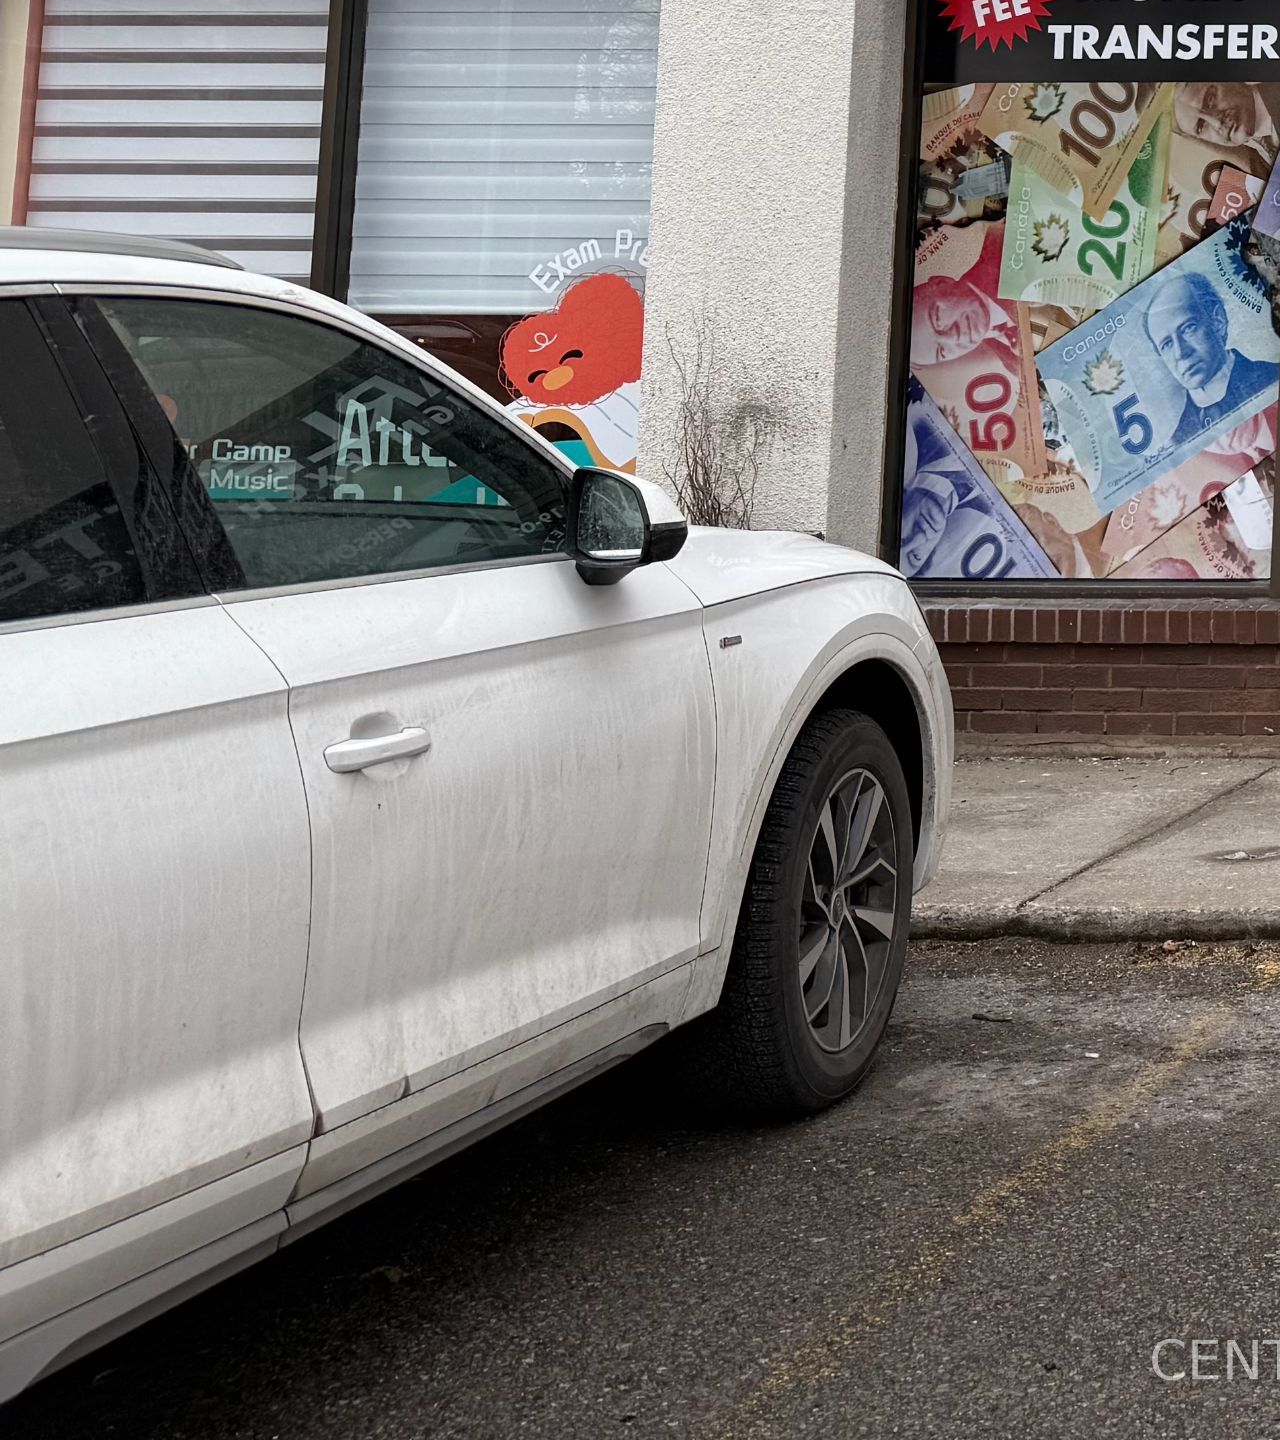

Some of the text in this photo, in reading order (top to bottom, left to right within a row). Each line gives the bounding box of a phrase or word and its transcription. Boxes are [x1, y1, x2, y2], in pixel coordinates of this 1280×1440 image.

[1047, 24, 1280, 61] TRANSFER
[1010, 186, 1032, 270] Canada
[1076, 199, 1131, 280] 20
[528, 238, 602, 294] Exam
[1232, 286, 1263, 314] BANQUE
[1062, 312, 1127, 363] Canada
[964, 371, 1017, 452] 50
[1111, 392, 1154, 456] 5
[211, 438, 291, 463] Camp
[209, 468, 289, 491] Music
